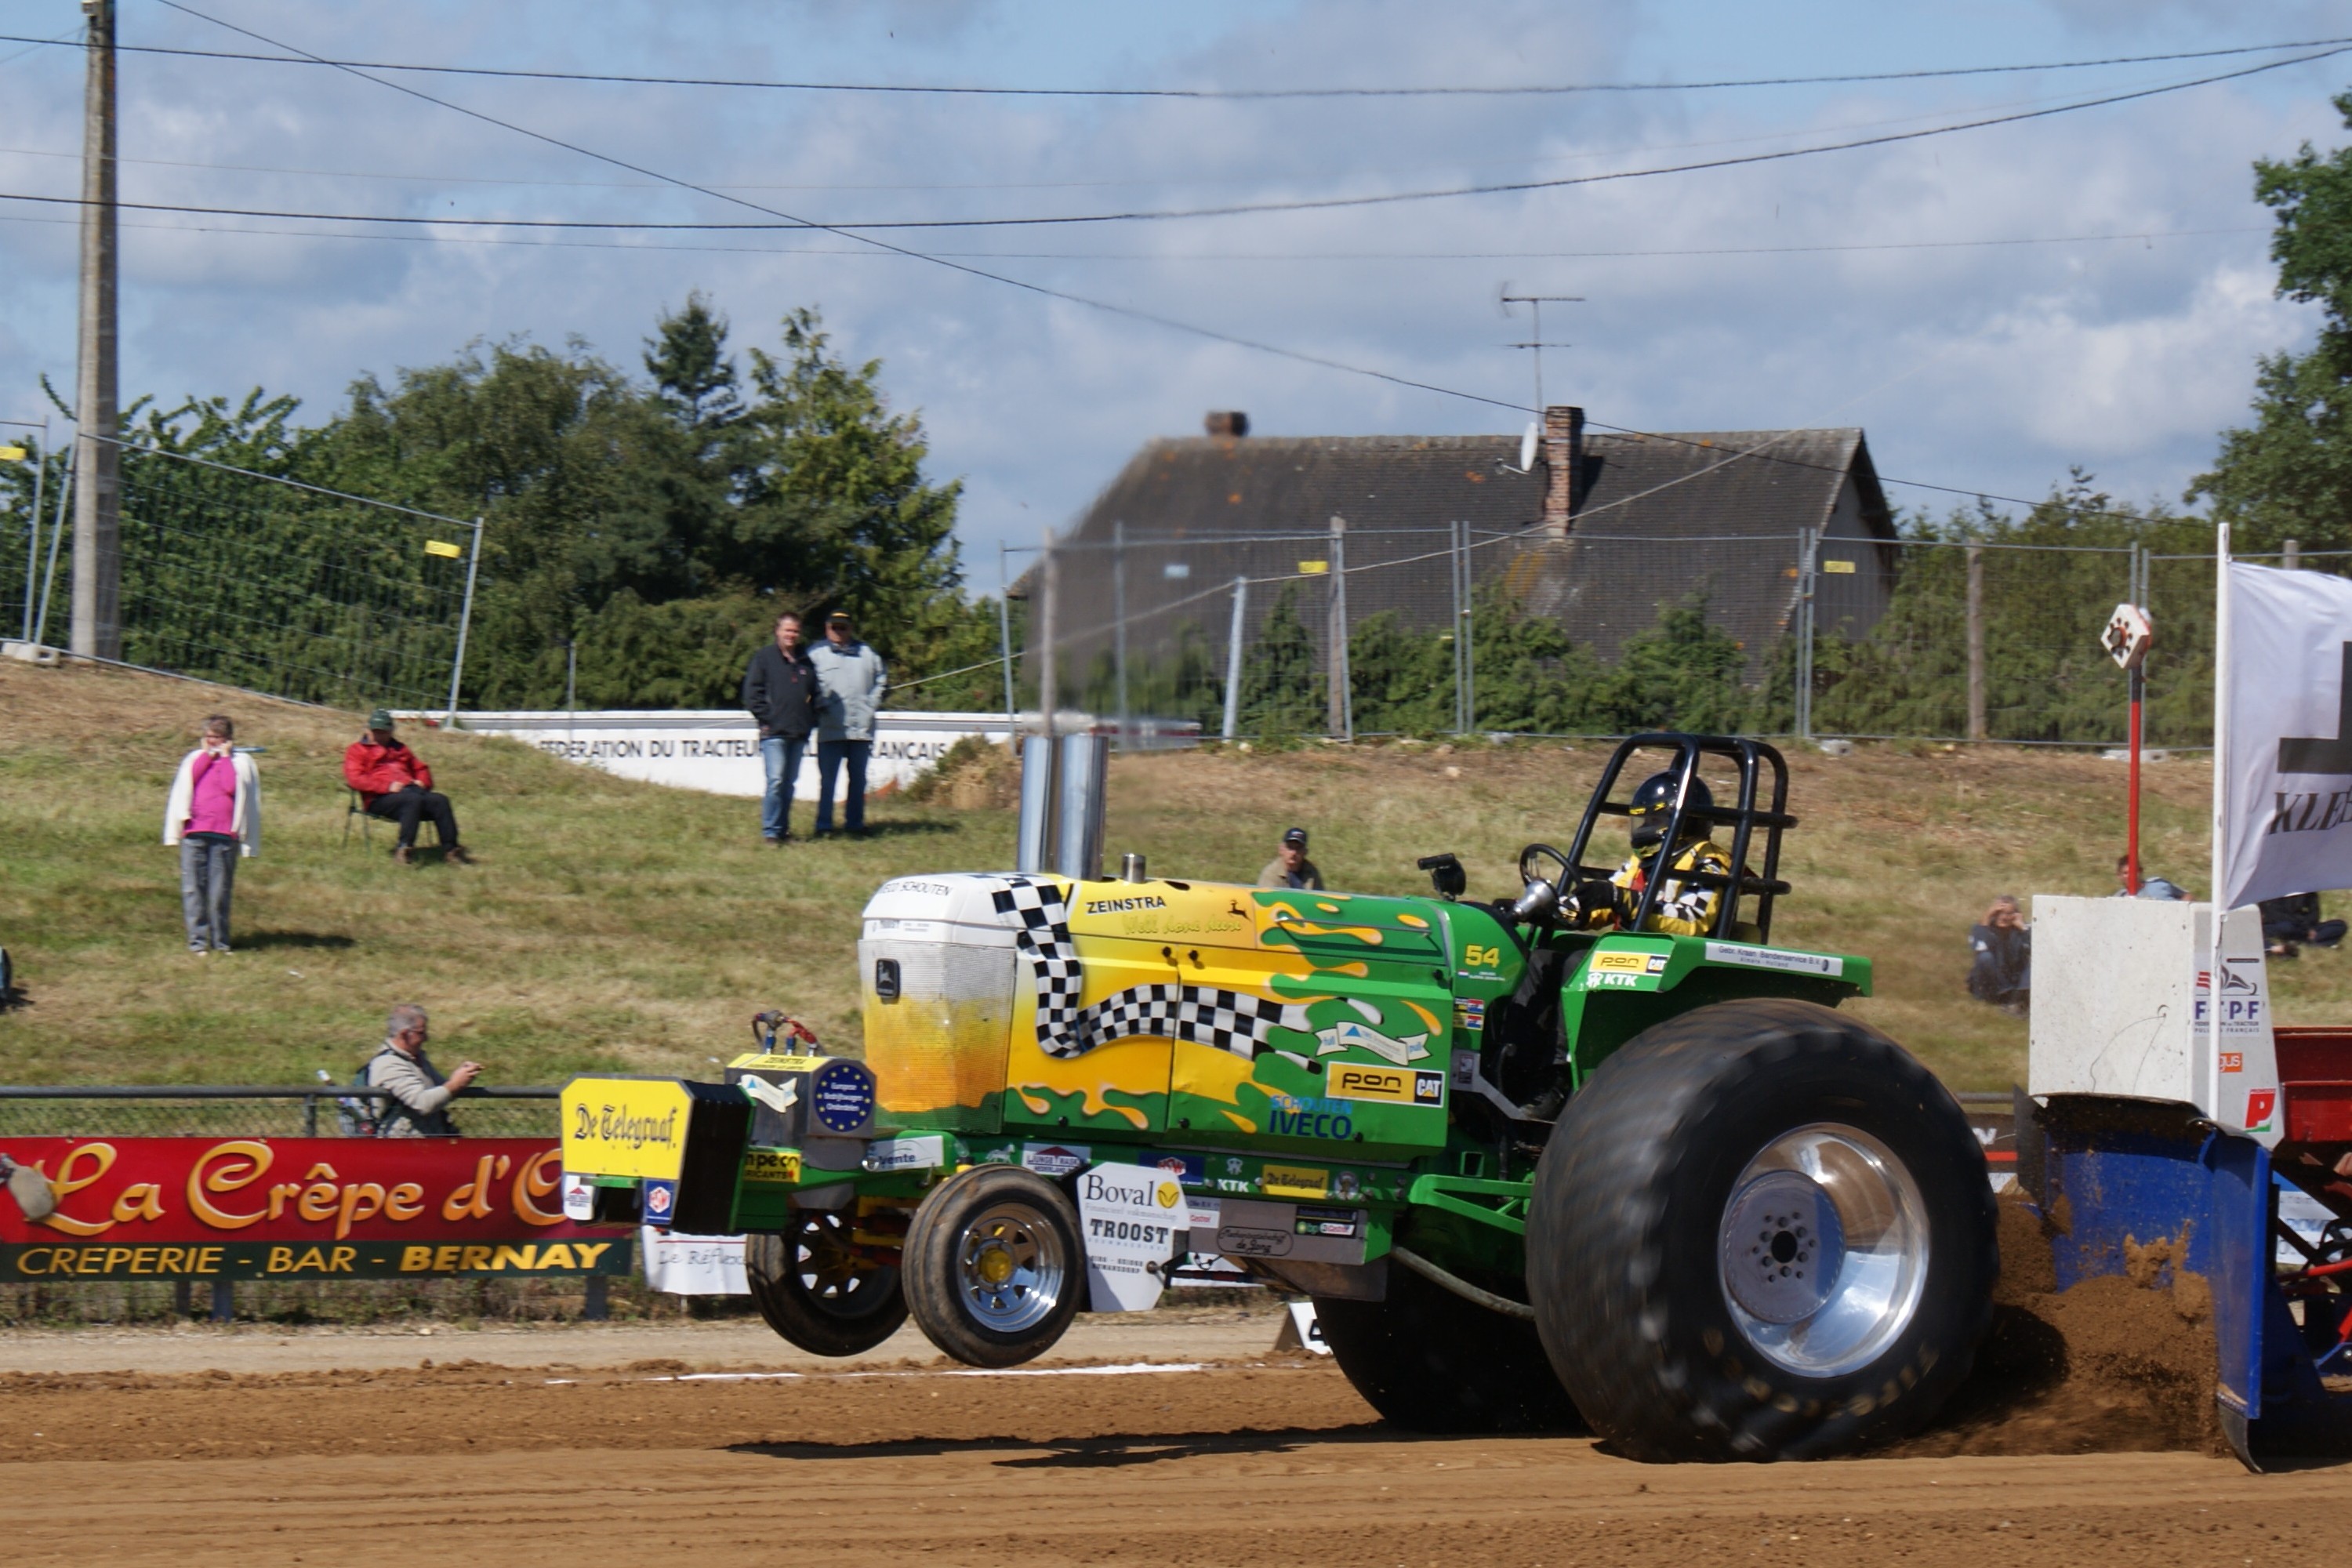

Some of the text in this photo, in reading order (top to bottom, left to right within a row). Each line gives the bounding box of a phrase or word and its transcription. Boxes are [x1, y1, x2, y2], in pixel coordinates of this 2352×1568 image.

[650, 740, 673, 758] DU
[1086, 895, 1167, 915] ZEINSTRA
[1465, 945, 1501, 969] 54
[1601, 956, 1639, 966] pon
[1604, 973, 1639, 987] KTK
[1342, 1073, 1441, 1098] pon CAT
[1269, 1094, 1352, 1114] SCHOUTEN
[574, 1103, 597, 1140] De
[1269, 1110, 1352, 1140] IVECO
[24, 1142, 166, 1237] La
[186, 1140, 425, 1241] Crêpe
[1085, 1174, 1154, 1207] Boval
[1217, 1178, 1250, 1193] KTK
[1090, 1218, 1169, 1245] TROOST
[17, 1247, 226, 1276] CREPERIE
[266, 1247, 358, 1274] BAR
[398, 1243, 612, 1272] BERNAY
[659, 1250, 683, 1265] Le
